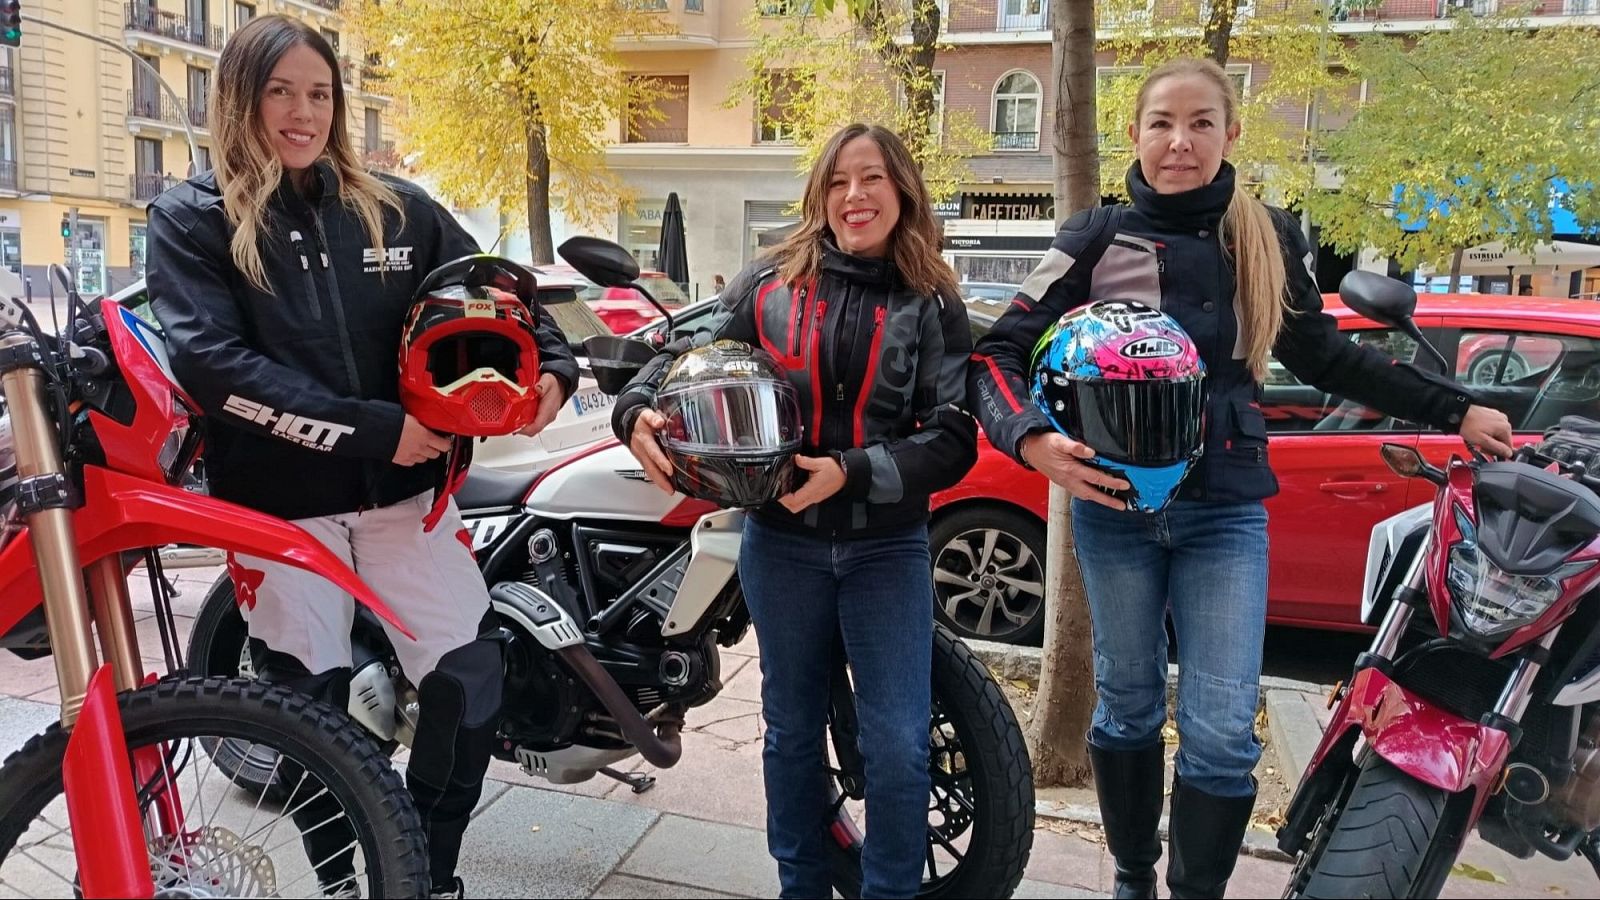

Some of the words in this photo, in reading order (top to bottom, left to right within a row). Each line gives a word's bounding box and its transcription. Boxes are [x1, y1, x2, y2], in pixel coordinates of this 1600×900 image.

[971, 204, 1041, 220] CAFETERIA
[363, 247, 413, 262] SHOT
[468, 303, 492, 311] FOX
[1130, 341, 1176, 355] HJC
[580, 392, 606, 411] 6492
[977, 378, 1004, 423] DAINESE
[222, 394, 356, 447] SHOT
[271, 430, 300, 443] RACE
[301, 440, 333, 452] GEAR
